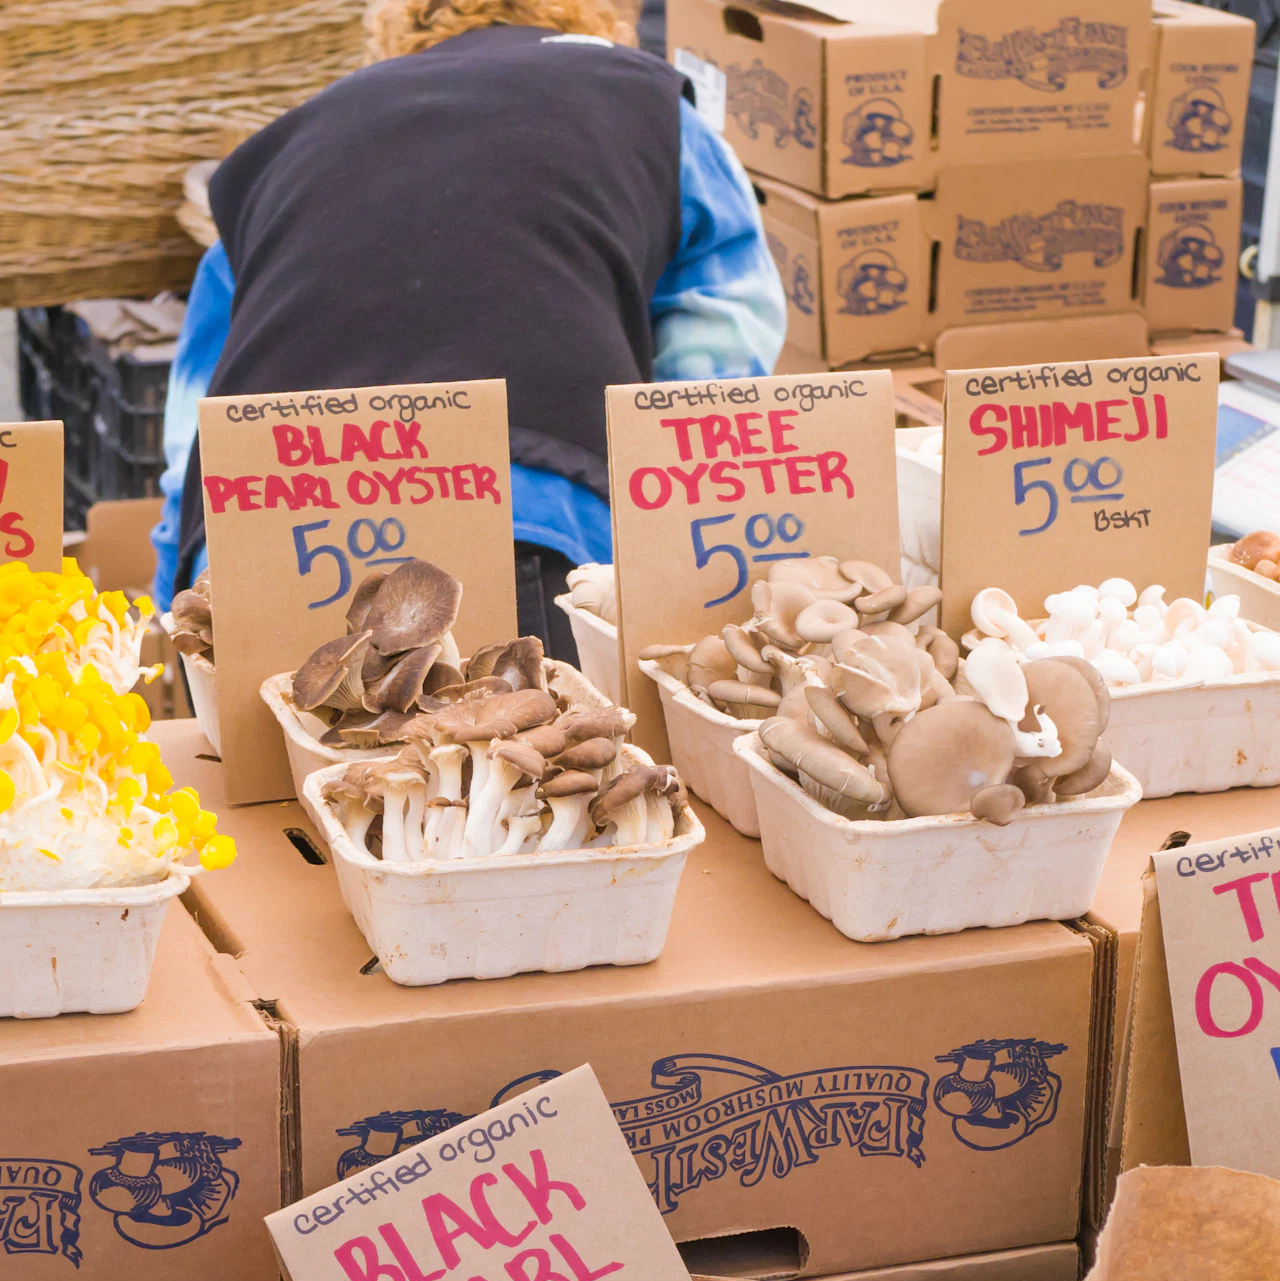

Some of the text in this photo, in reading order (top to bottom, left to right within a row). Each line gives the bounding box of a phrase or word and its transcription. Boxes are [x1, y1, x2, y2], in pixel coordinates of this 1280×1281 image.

[634, 380, 868, 412] certified organic
[965, 362, 1201, 397] certified organic
[226, 390, 472, 424] certified organic
[969, 394, 1168, 457] SHIMEJI
[272, 420, 429, 467] BLACK
[660, 409, 800, 462] TREE
[203, 463, 502, 514] PEARL OYSTER
[629, 451, 855, 511] OYSTER
[645, 1087, 697, 1112] MOSS
[814, 1072, 911, 1093] QUALITY
[661, 1079, 803, 1140] MUSHROOM
[292, 1096, 558, 1235] certified organic
